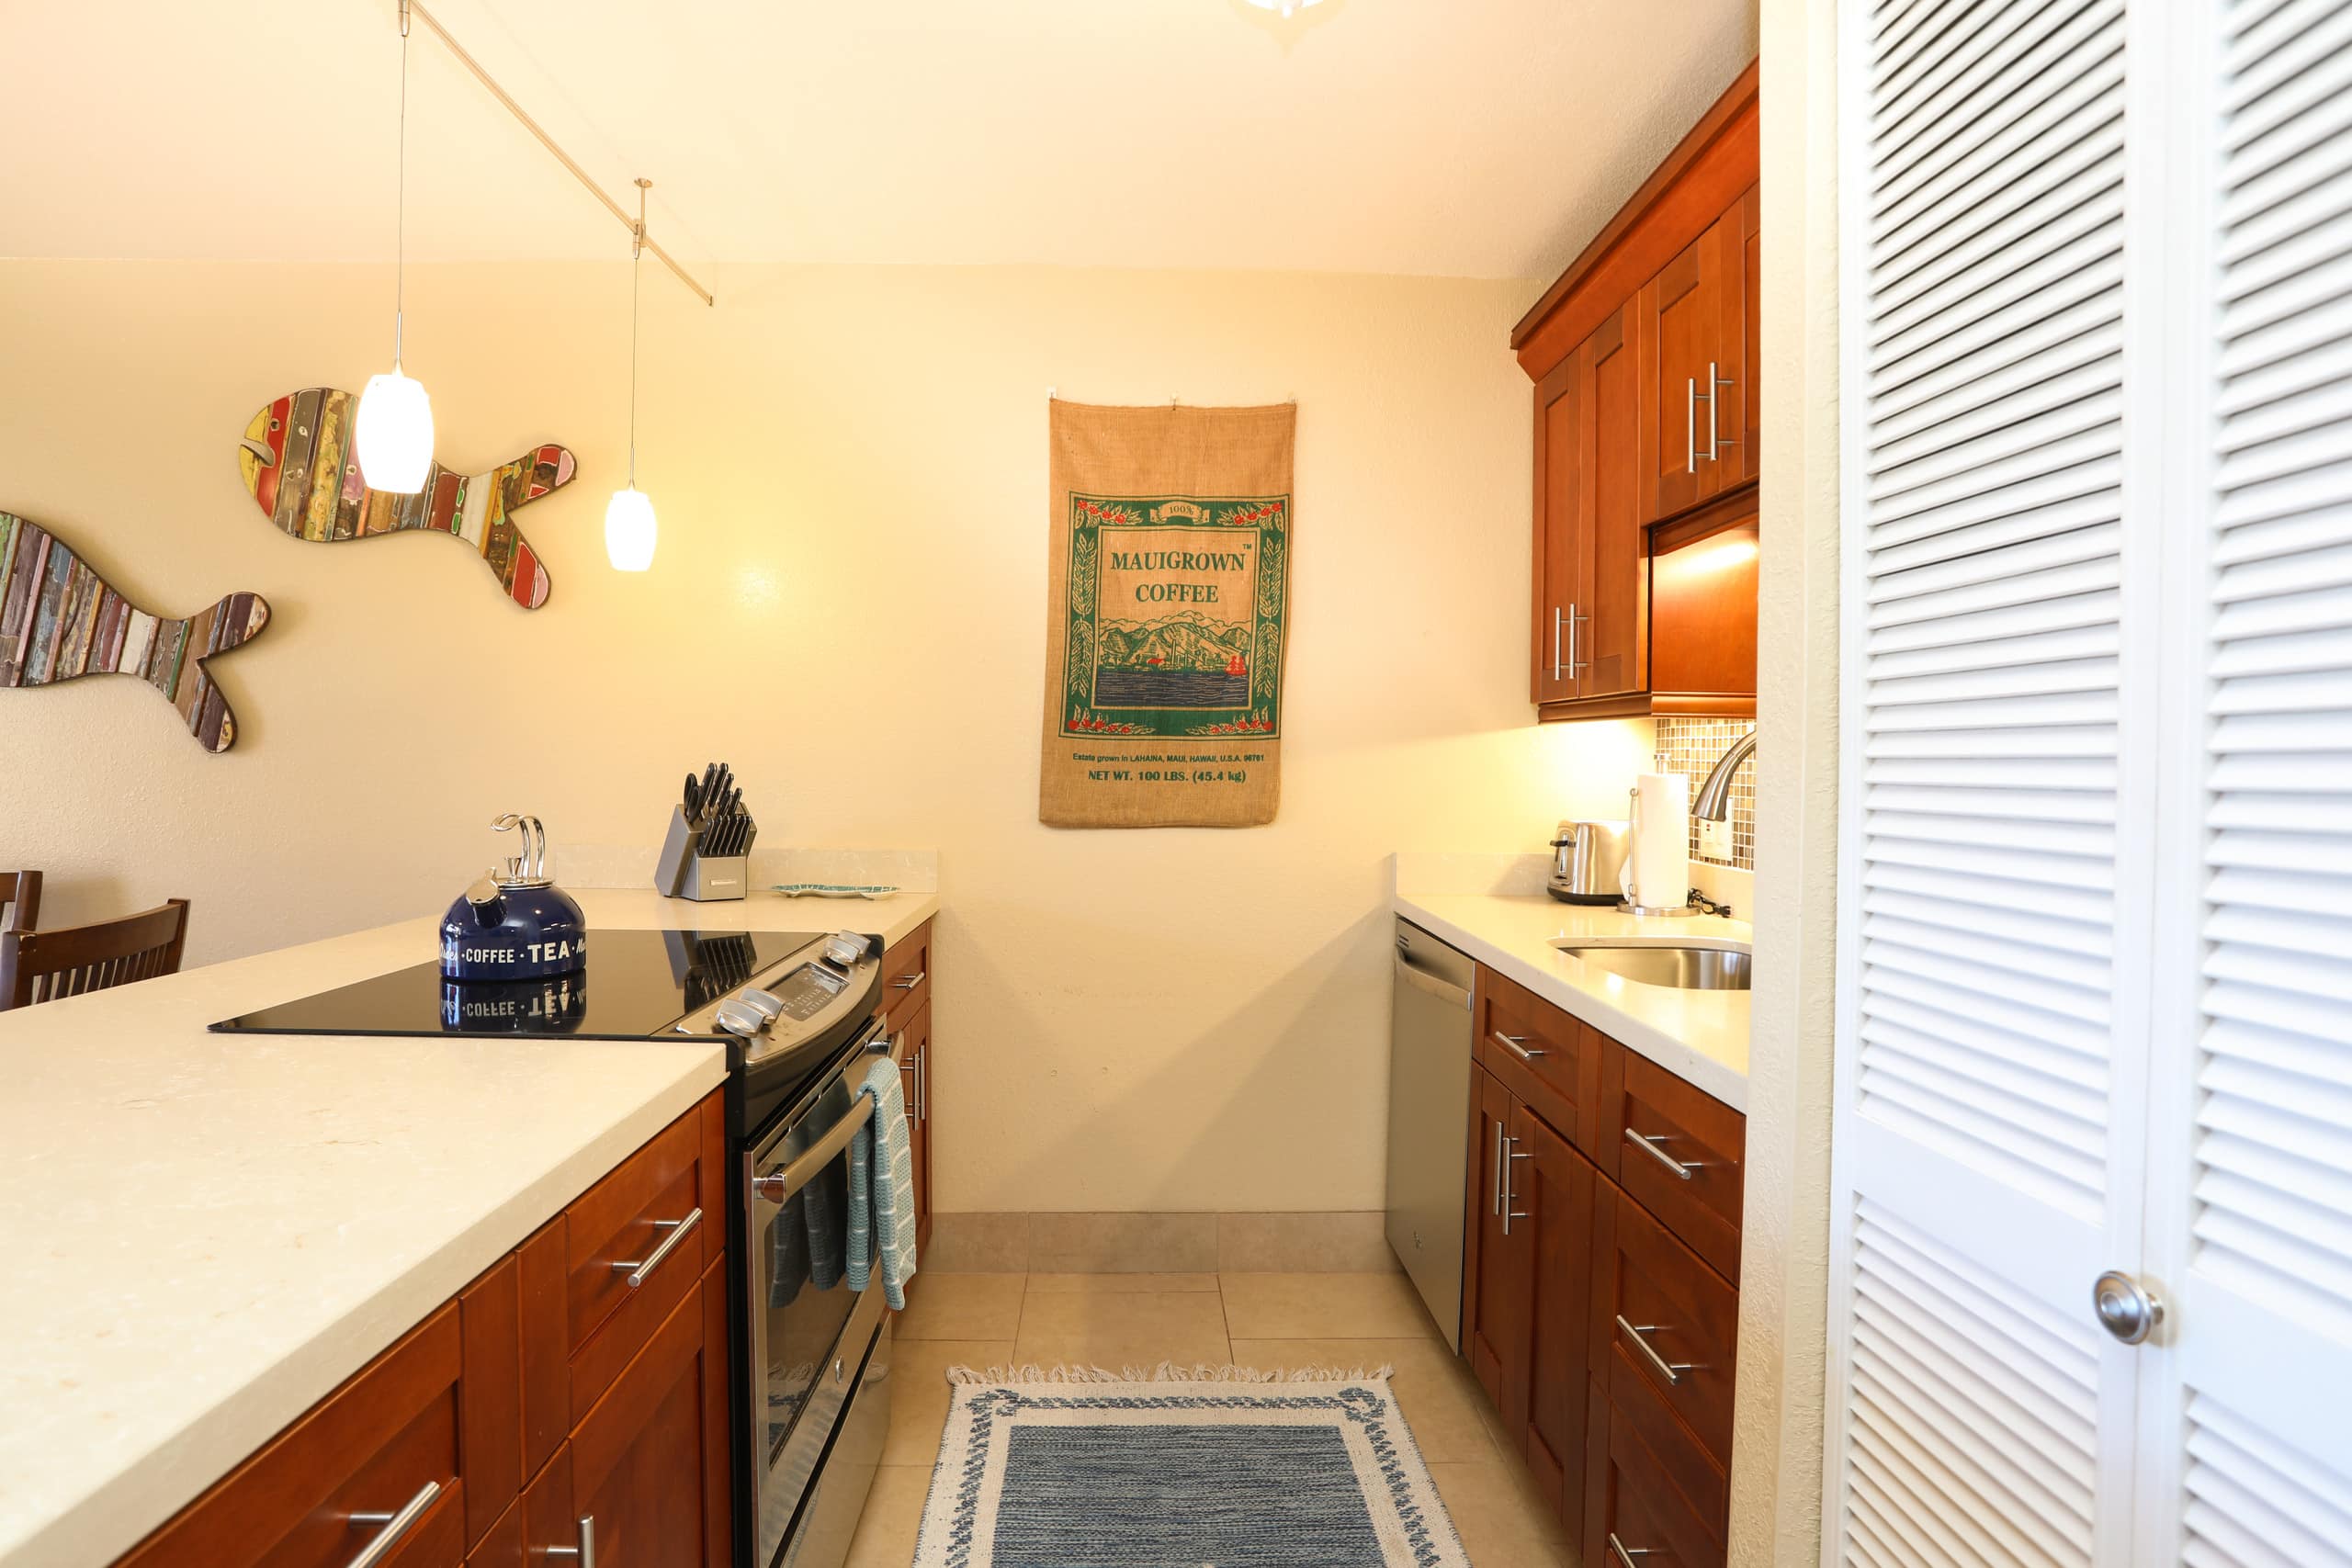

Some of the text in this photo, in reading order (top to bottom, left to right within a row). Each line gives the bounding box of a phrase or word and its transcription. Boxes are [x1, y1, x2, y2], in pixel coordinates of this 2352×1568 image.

[1169, 505, 1193, 515] 100%
[1110, 551, 1246, 571] MAUIGROWN
[1136, 583, 1218, 603] COFFEE
[1072, 752, 1095, 761] Estate
[1097, 754, 1119, 763] grown
[1130, 754, 1165, 763] LAHAINA,
[1166, 754, 1188, 763] MAUI,
[1088, 770, 1247, 784] NET WT. 100 LBS. (45.4 kg)
[466, 948, 514, 964] COFFEE
[527, 940, 571, 964] TEA
